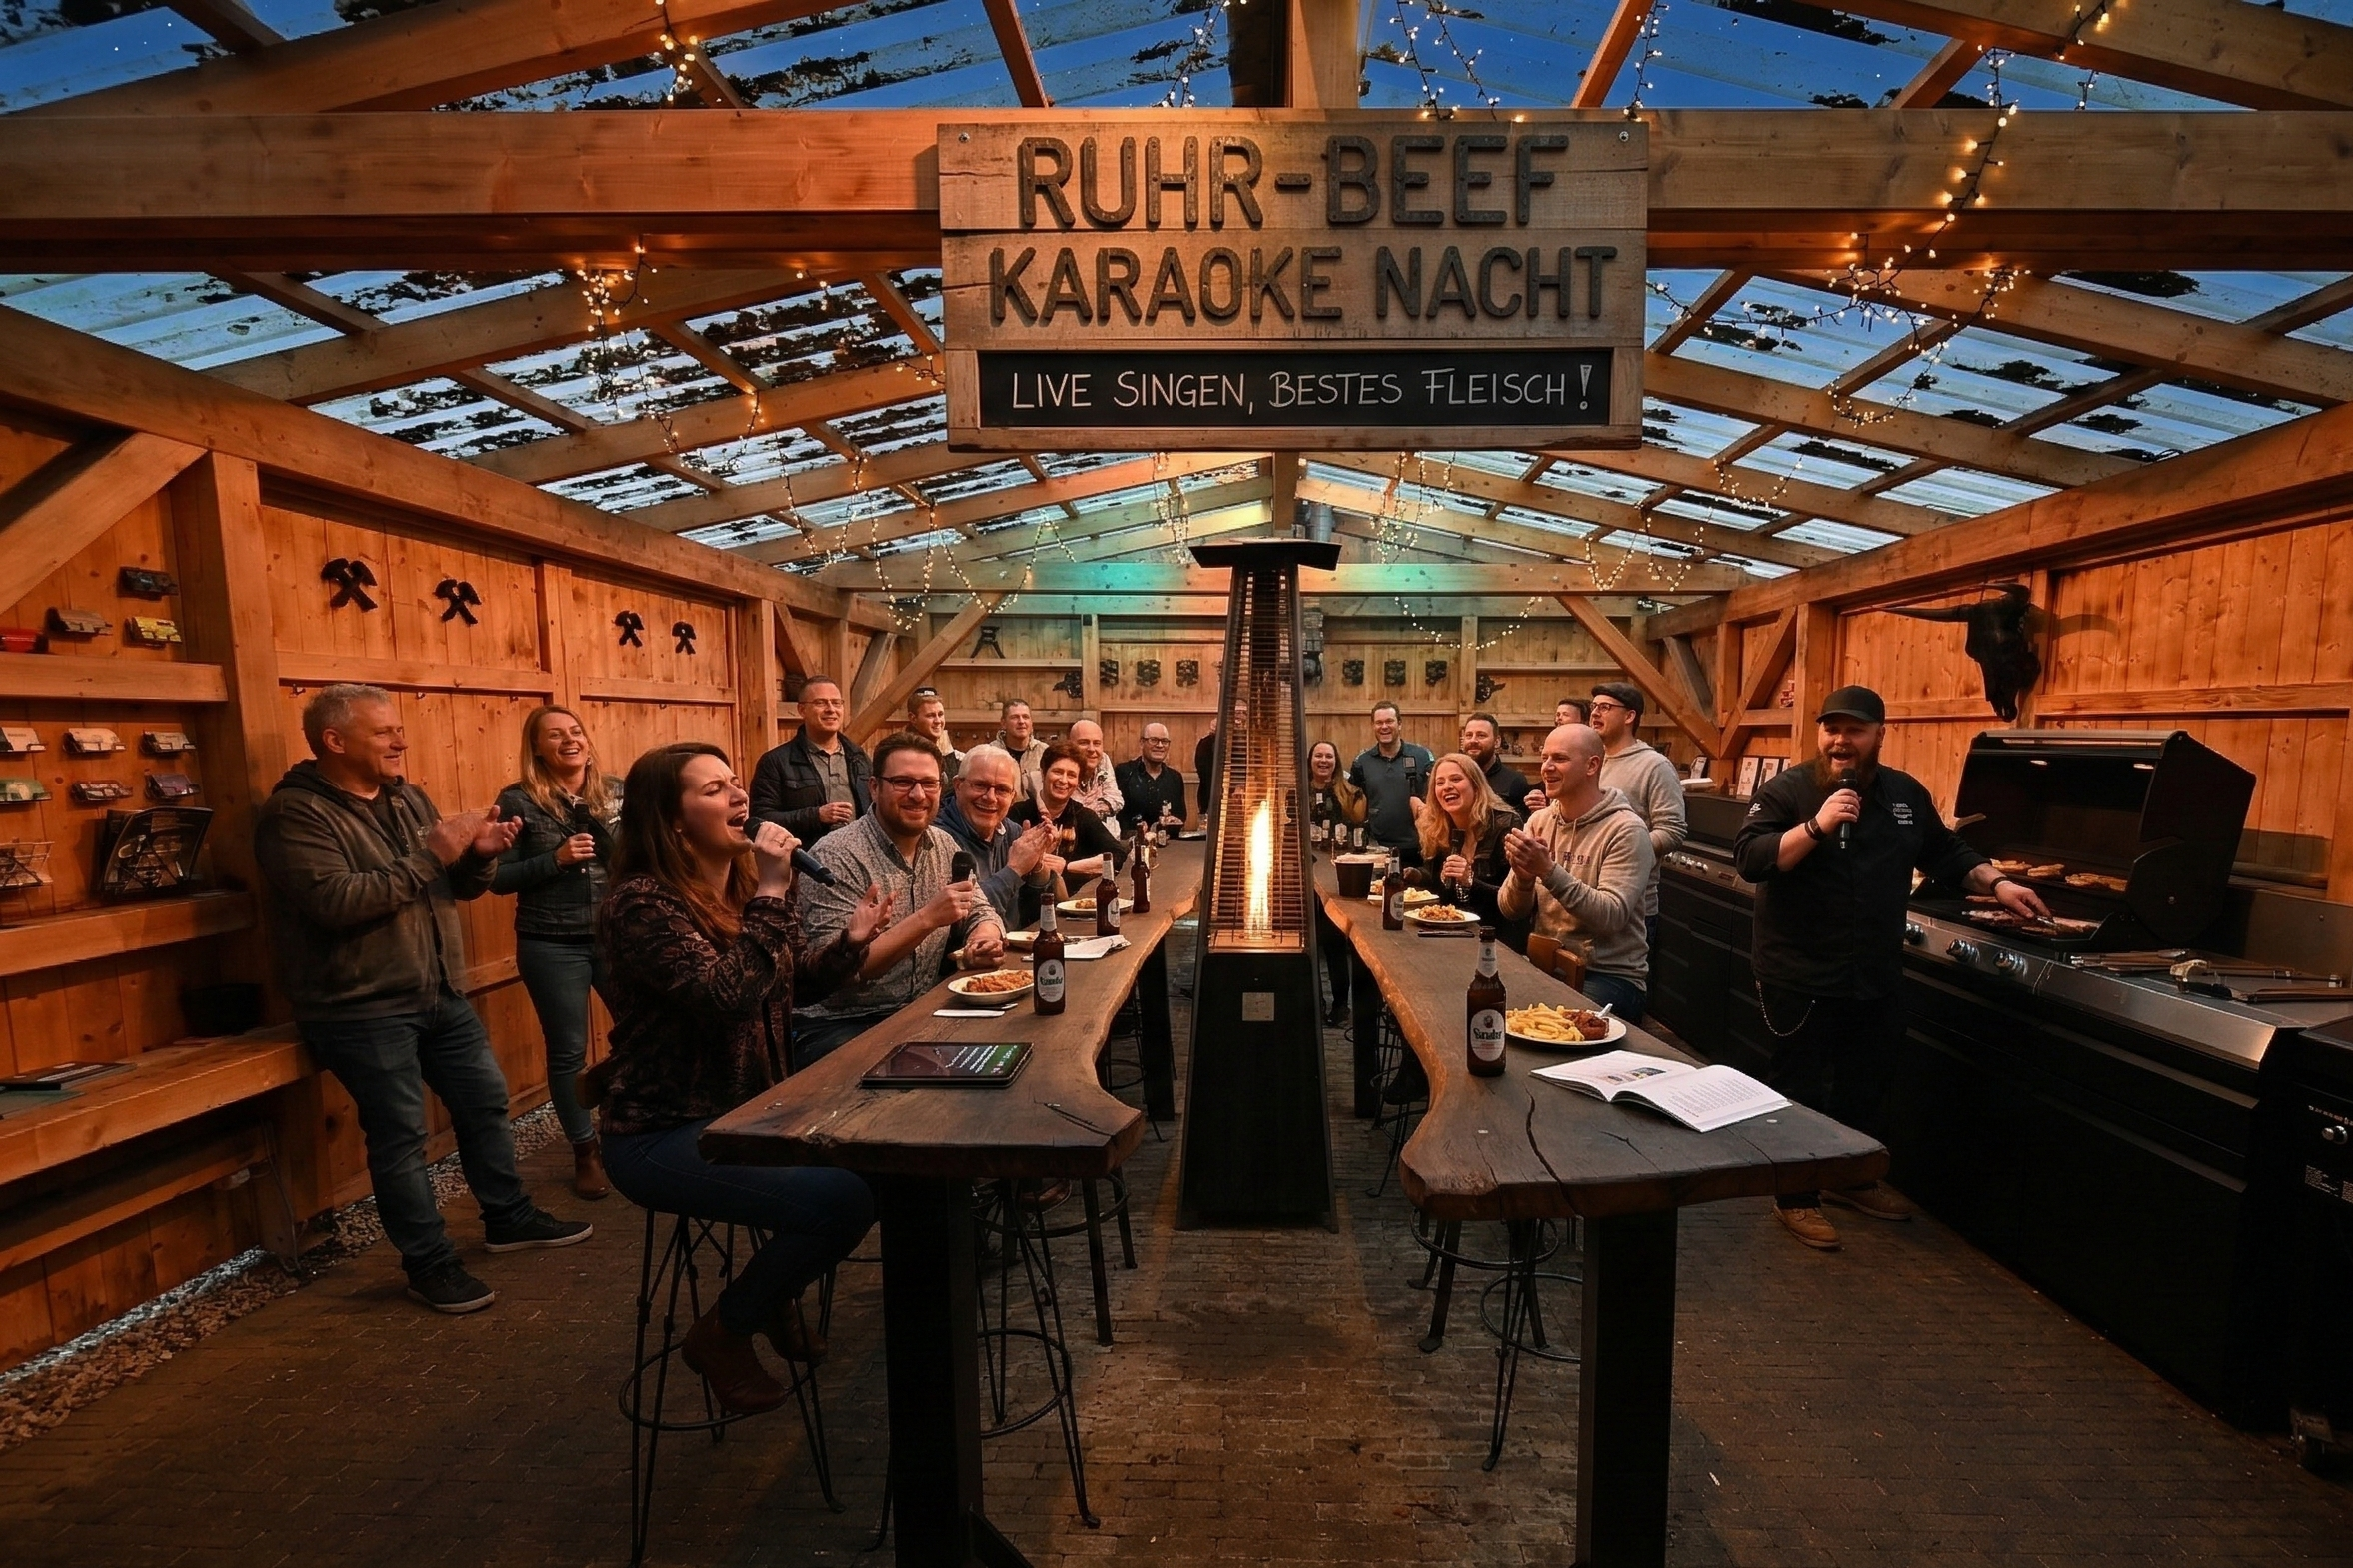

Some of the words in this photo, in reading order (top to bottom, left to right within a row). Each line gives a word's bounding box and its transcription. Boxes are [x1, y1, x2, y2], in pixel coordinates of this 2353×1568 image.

[1019, 136, 1569, 226] RUHR-BEEF
[991, 246, 1342, 322] KARAOKE
[1377, 246, 1617, 319] NACHT
[1013, 372, 1092, 409] LIVE
[1114, 371, 1254, 415] SINGEN,
[1269, 371, 1403, 406] BESTES
